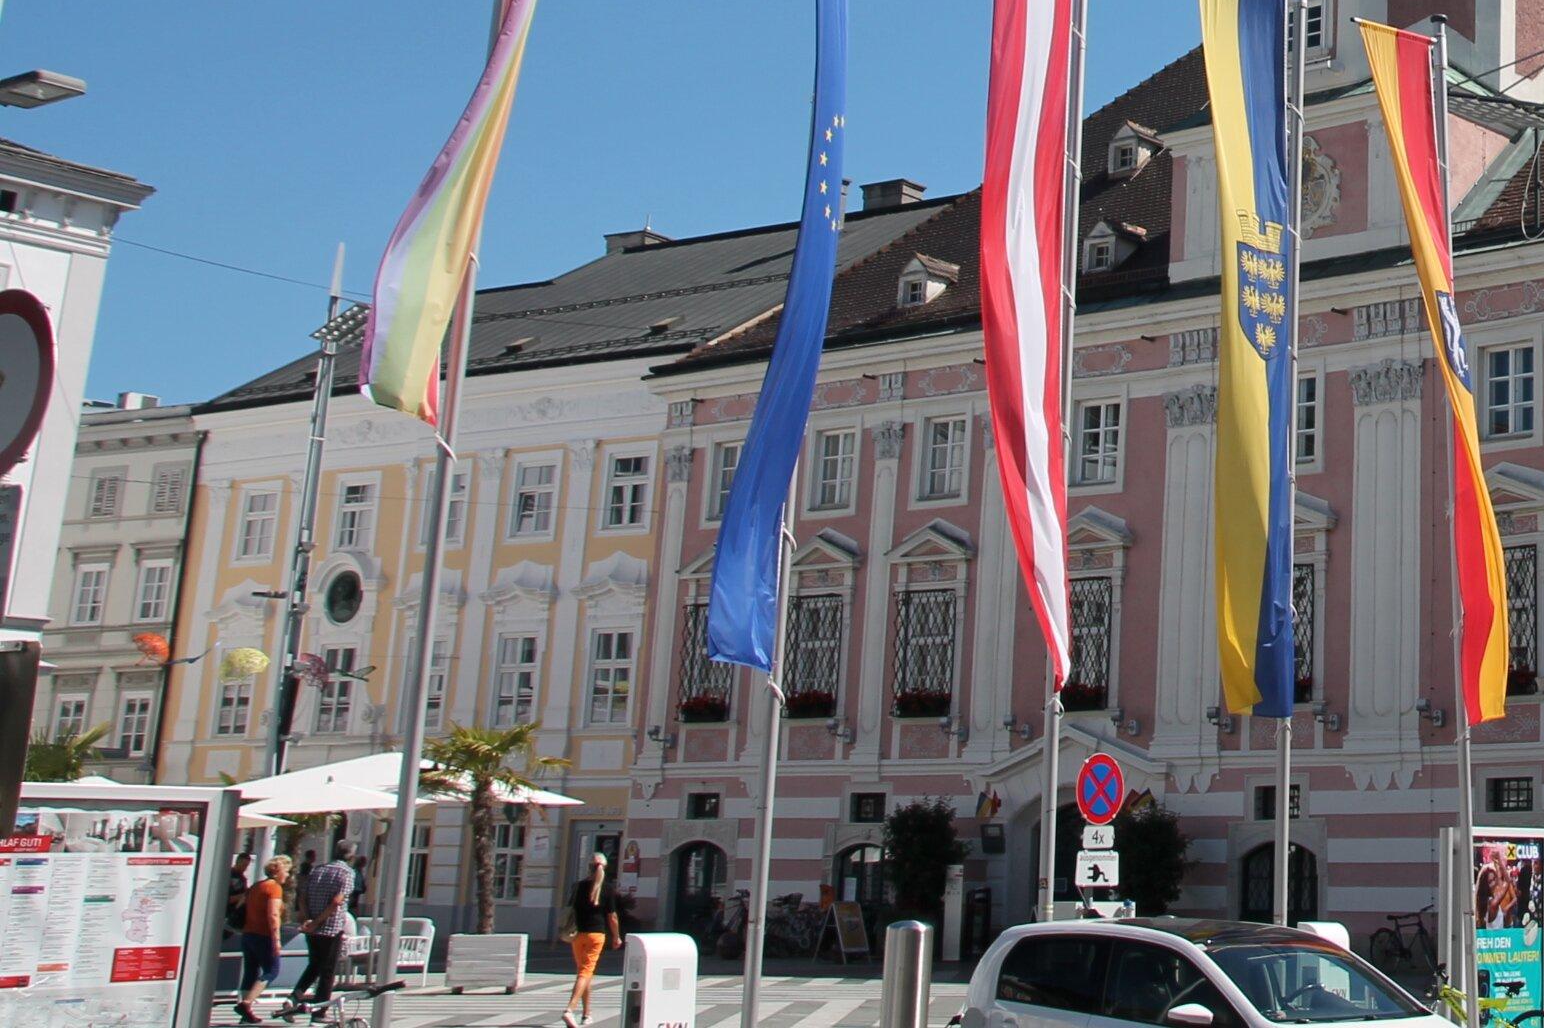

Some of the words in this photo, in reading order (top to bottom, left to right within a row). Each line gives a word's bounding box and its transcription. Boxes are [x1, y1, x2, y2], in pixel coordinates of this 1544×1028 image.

[1092, 830, 1105, 844] 4x
[1516, 844, 1539, 859] CLUB
[1477, 937, 1493, 949] REH
[1495, 937, 1511, 948] DEN
[1477, 951, 1507, 964] OMMER
[1508, 950, 1540, 963] LAUTER!
